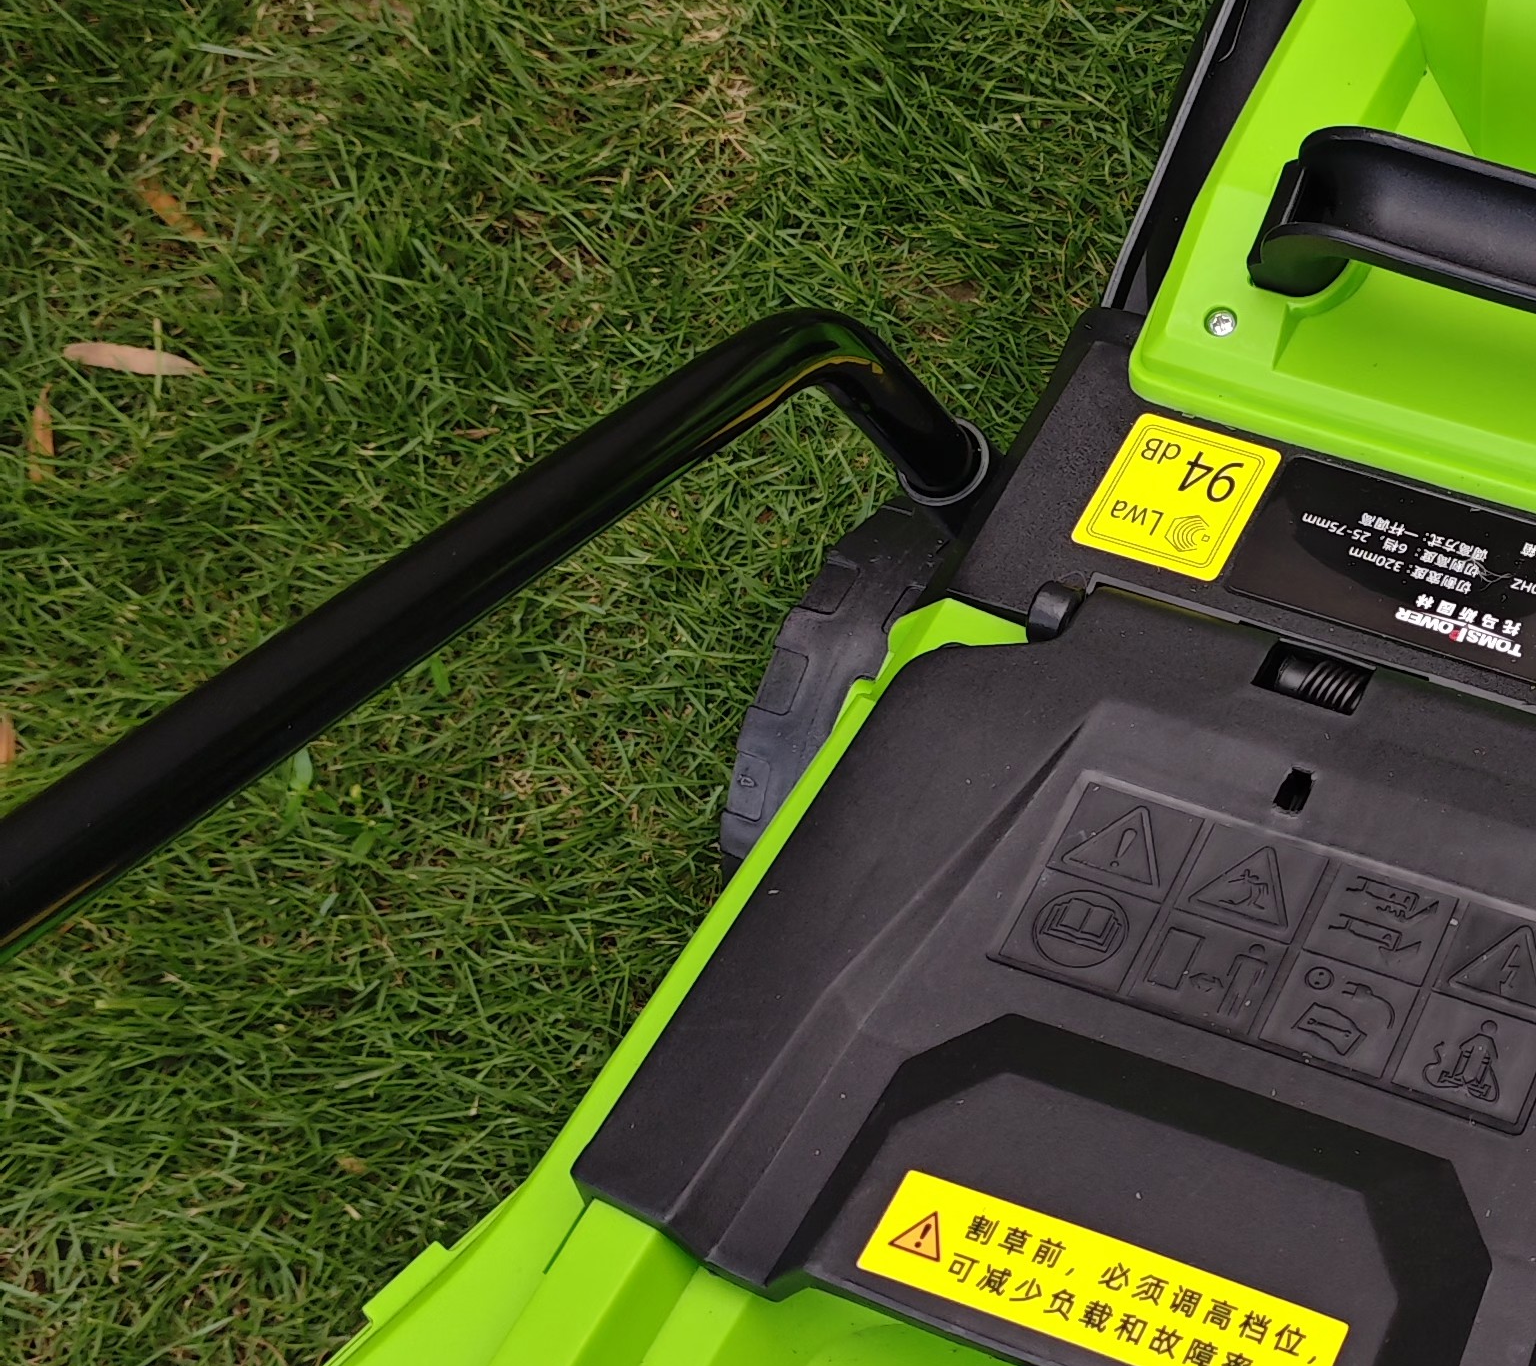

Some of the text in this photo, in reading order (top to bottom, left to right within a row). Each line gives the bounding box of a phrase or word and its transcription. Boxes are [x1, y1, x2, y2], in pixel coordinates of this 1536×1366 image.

[1140, 437, 1245, 502] 94 dB
[1110, 499, 1164, 536] Lwa
[1395, 606, 1522, 658] TOMSPOWER
[1415, 593, 1522, 637] 托马斯园林
[963, 1213, 1318, 1365] 割草前，必须调高档位，
